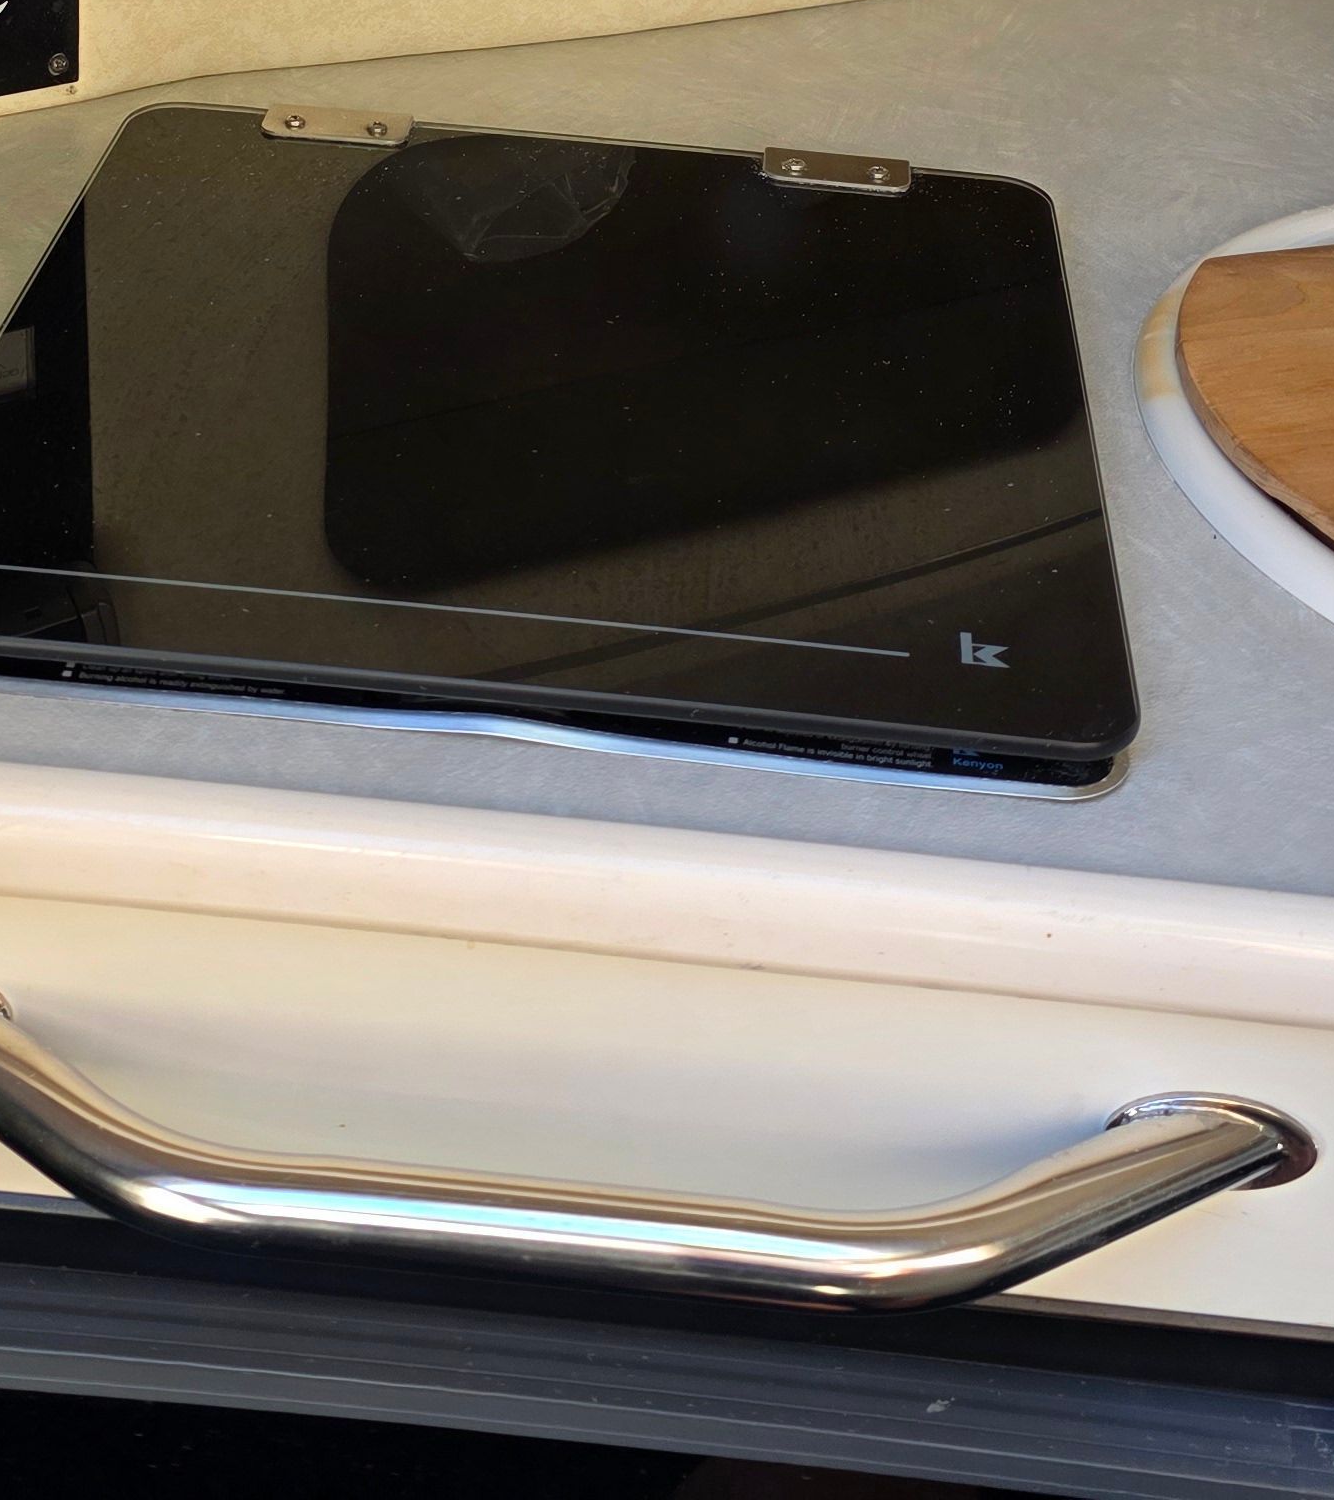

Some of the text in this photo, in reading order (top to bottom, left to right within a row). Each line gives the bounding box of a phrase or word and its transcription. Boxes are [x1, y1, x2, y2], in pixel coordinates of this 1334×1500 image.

[855, 751, 865, 761] in
[866, 753, 894, 766] bright
[953, 757, 1004, 772] Kenyon
